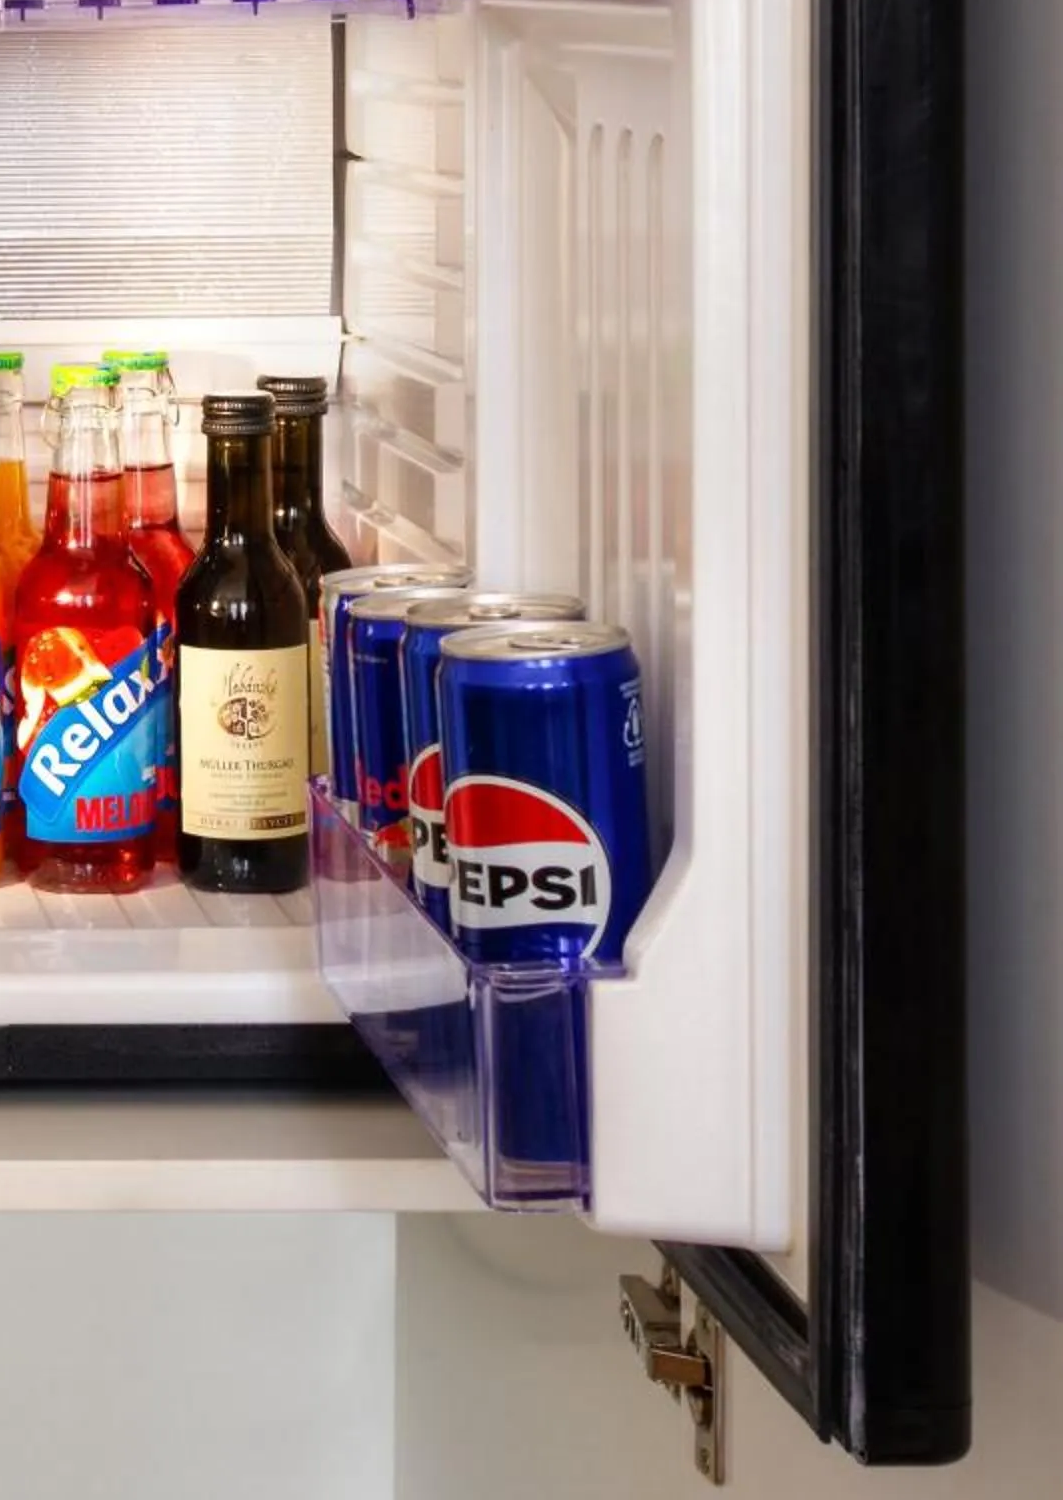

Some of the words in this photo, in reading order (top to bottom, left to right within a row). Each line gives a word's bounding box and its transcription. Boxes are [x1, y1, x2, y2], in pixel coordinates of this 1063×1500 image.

[31, 670, 155, 798] Relax
[356, 764, 410, 809] ed
[456, 860, 597, 911] EPSI
